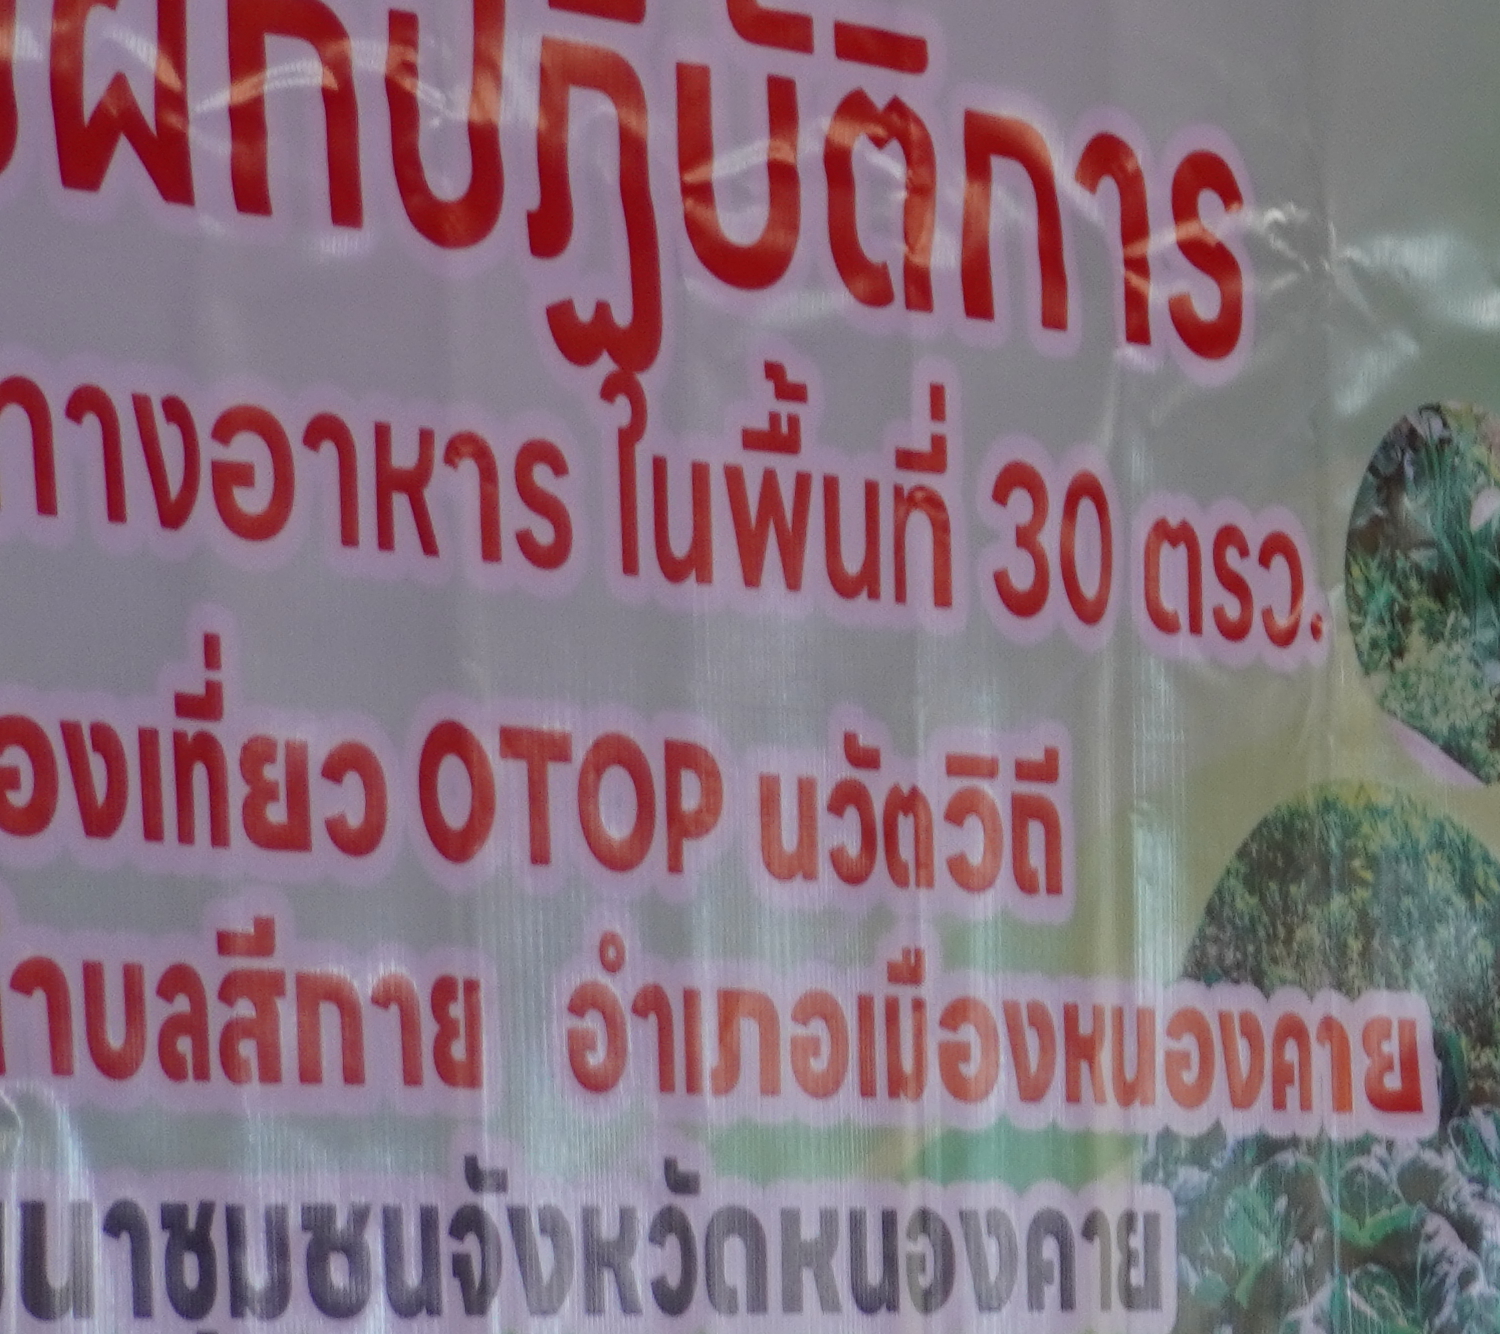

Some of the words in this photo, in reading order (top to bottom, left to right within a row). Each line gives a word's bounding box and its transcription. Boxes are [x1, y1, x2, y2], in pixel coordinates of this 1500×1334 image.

[598, 361, 953, 608] ในพื้นที่
[992, 459, 1113, 628] 30
[1143, 514, 1325, 649] ตรว.
[417, 718, 724, 875] OTOP
[758, 731, 1064, 898] นวัตวิถี
[566, 930, 1426, 1117] อำเภอเมืองหนองคาย
